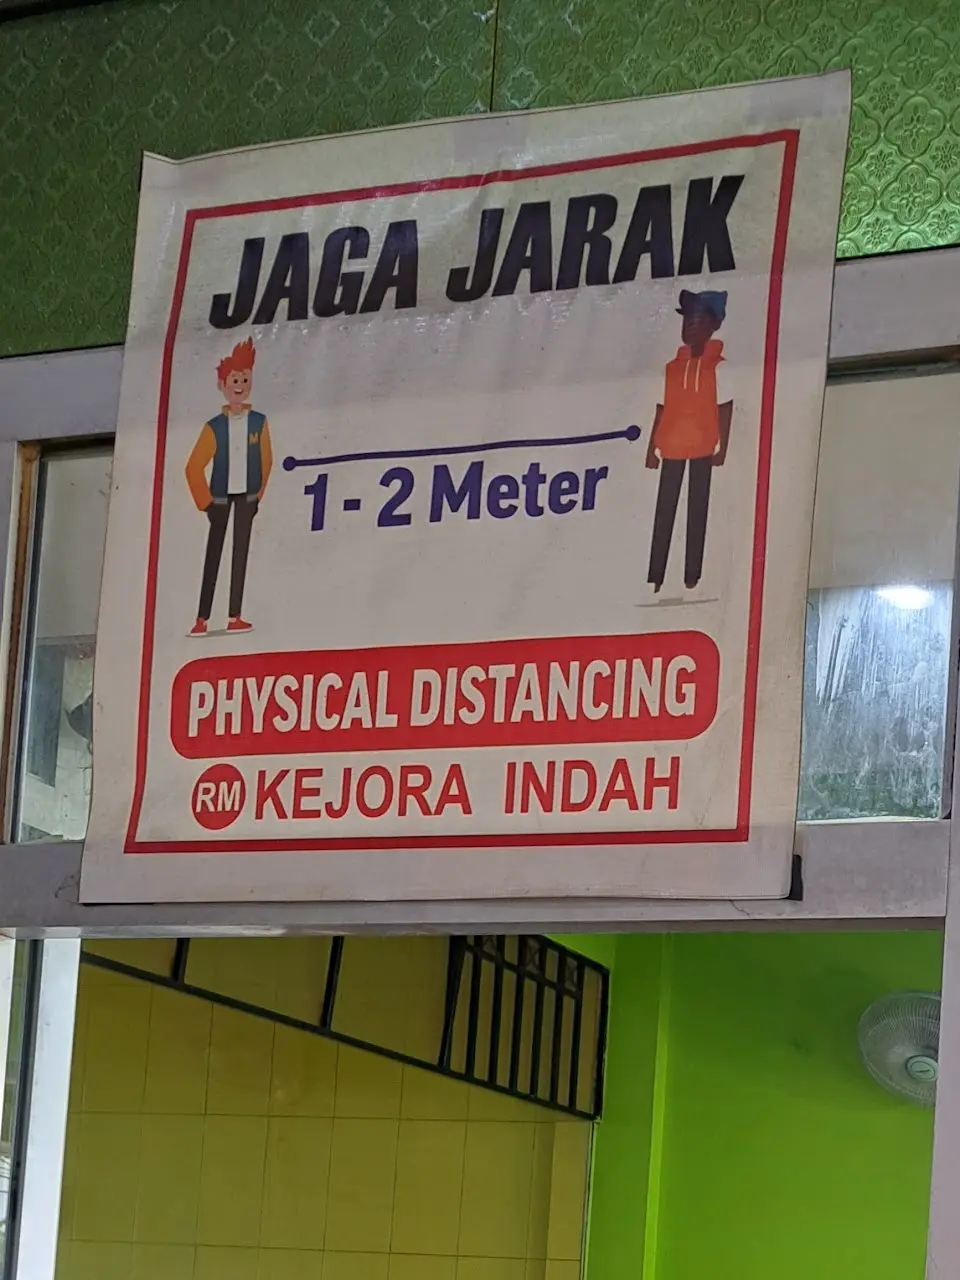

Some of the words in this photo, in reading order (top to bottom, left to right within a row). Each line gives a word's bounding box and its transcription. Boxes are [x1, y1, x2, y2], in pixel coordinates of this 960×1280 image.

[208, 219, 417, 329] JAGA
[446, 175, 745, 303] JARAK
[429, 460, 609, 523] Meter
[187, 670, 398, 737] PHYSICAL
[410, 655, 697, 728] DISTANCING
[195, 780, 242, 813] RM
[255, 762, 472, 821] KEJORA
[504, 756, 681, 815] INDAH
